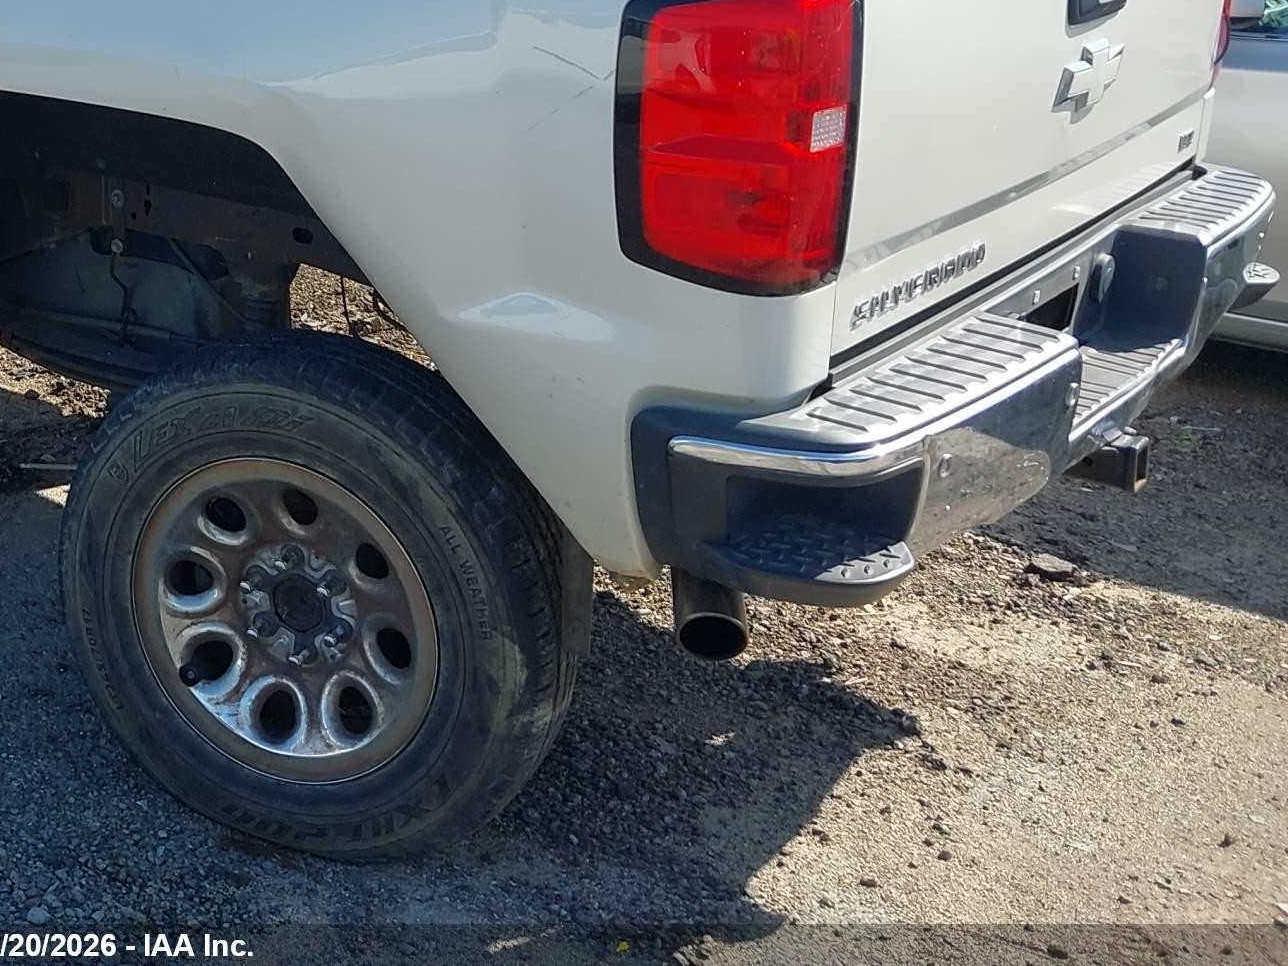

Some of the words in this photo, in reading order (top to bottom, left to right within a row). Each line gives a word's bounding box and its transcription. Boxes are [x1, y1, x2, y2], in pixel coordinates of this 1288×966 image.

[850, 241, 986, 331] SILVERADO
[438, 525, 462, 555] ALL
[459, 559, 493, 641] WEATHER
